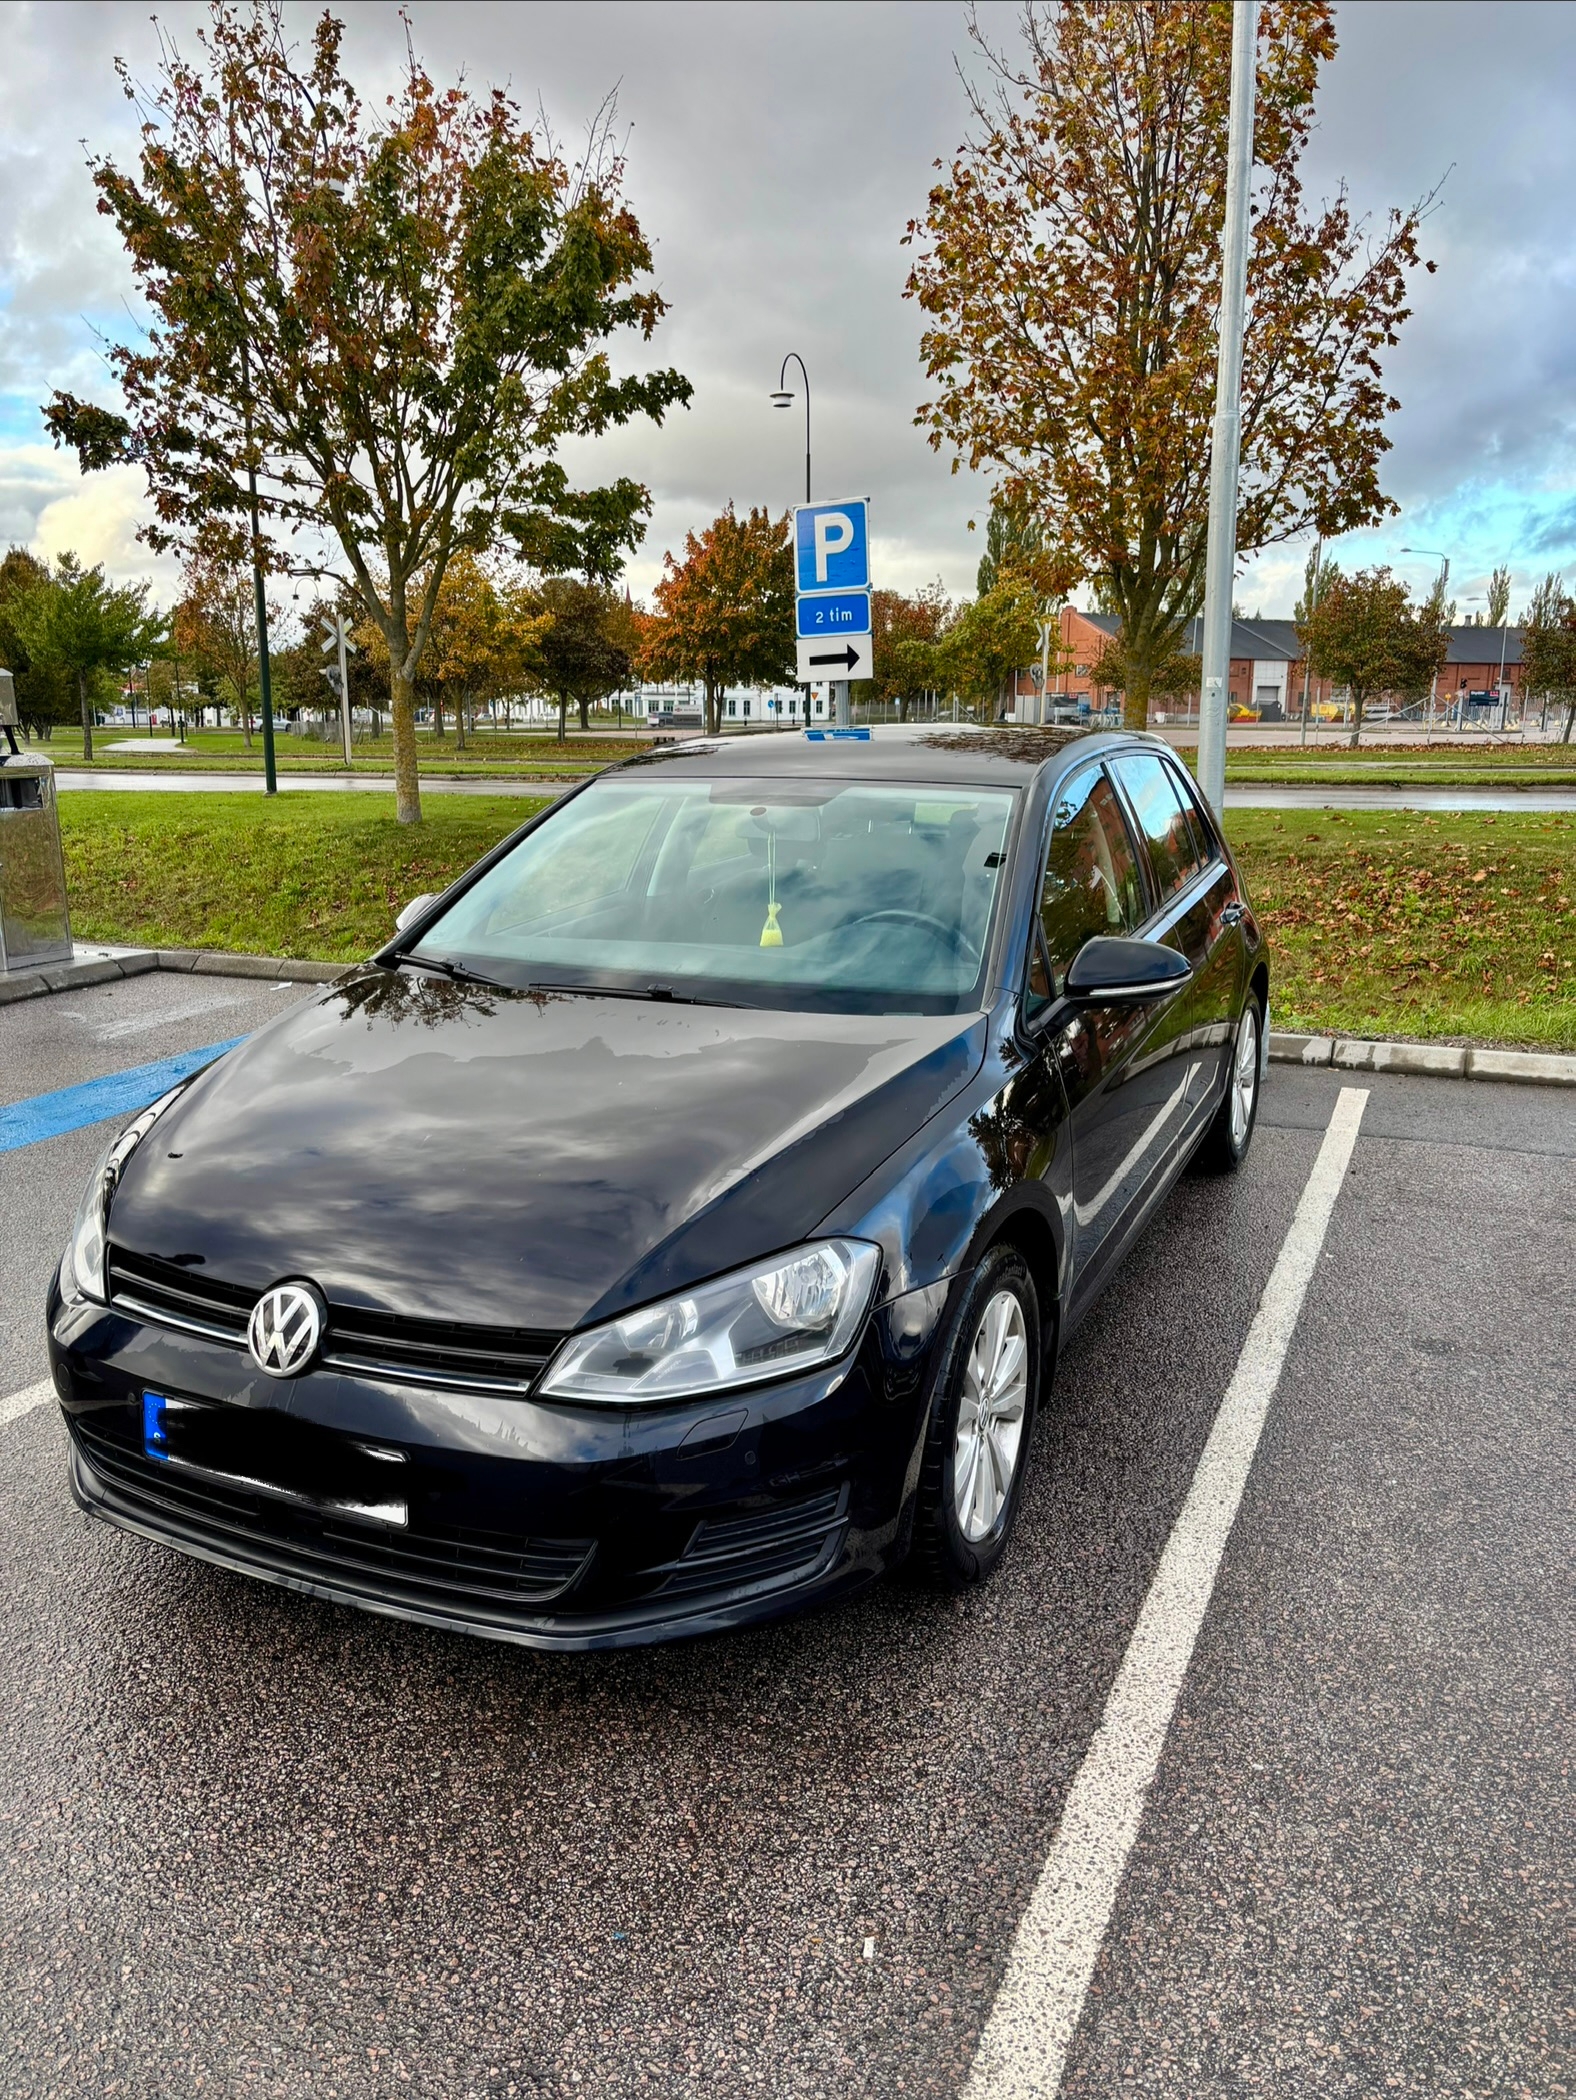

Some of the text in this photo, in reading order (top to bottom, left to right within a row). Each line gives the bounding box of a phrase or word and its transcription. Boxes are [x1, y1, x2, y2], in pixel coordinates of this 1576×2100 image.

[814, 512, 854, 582] P
[816, 606, 852, 624] 2 tim
